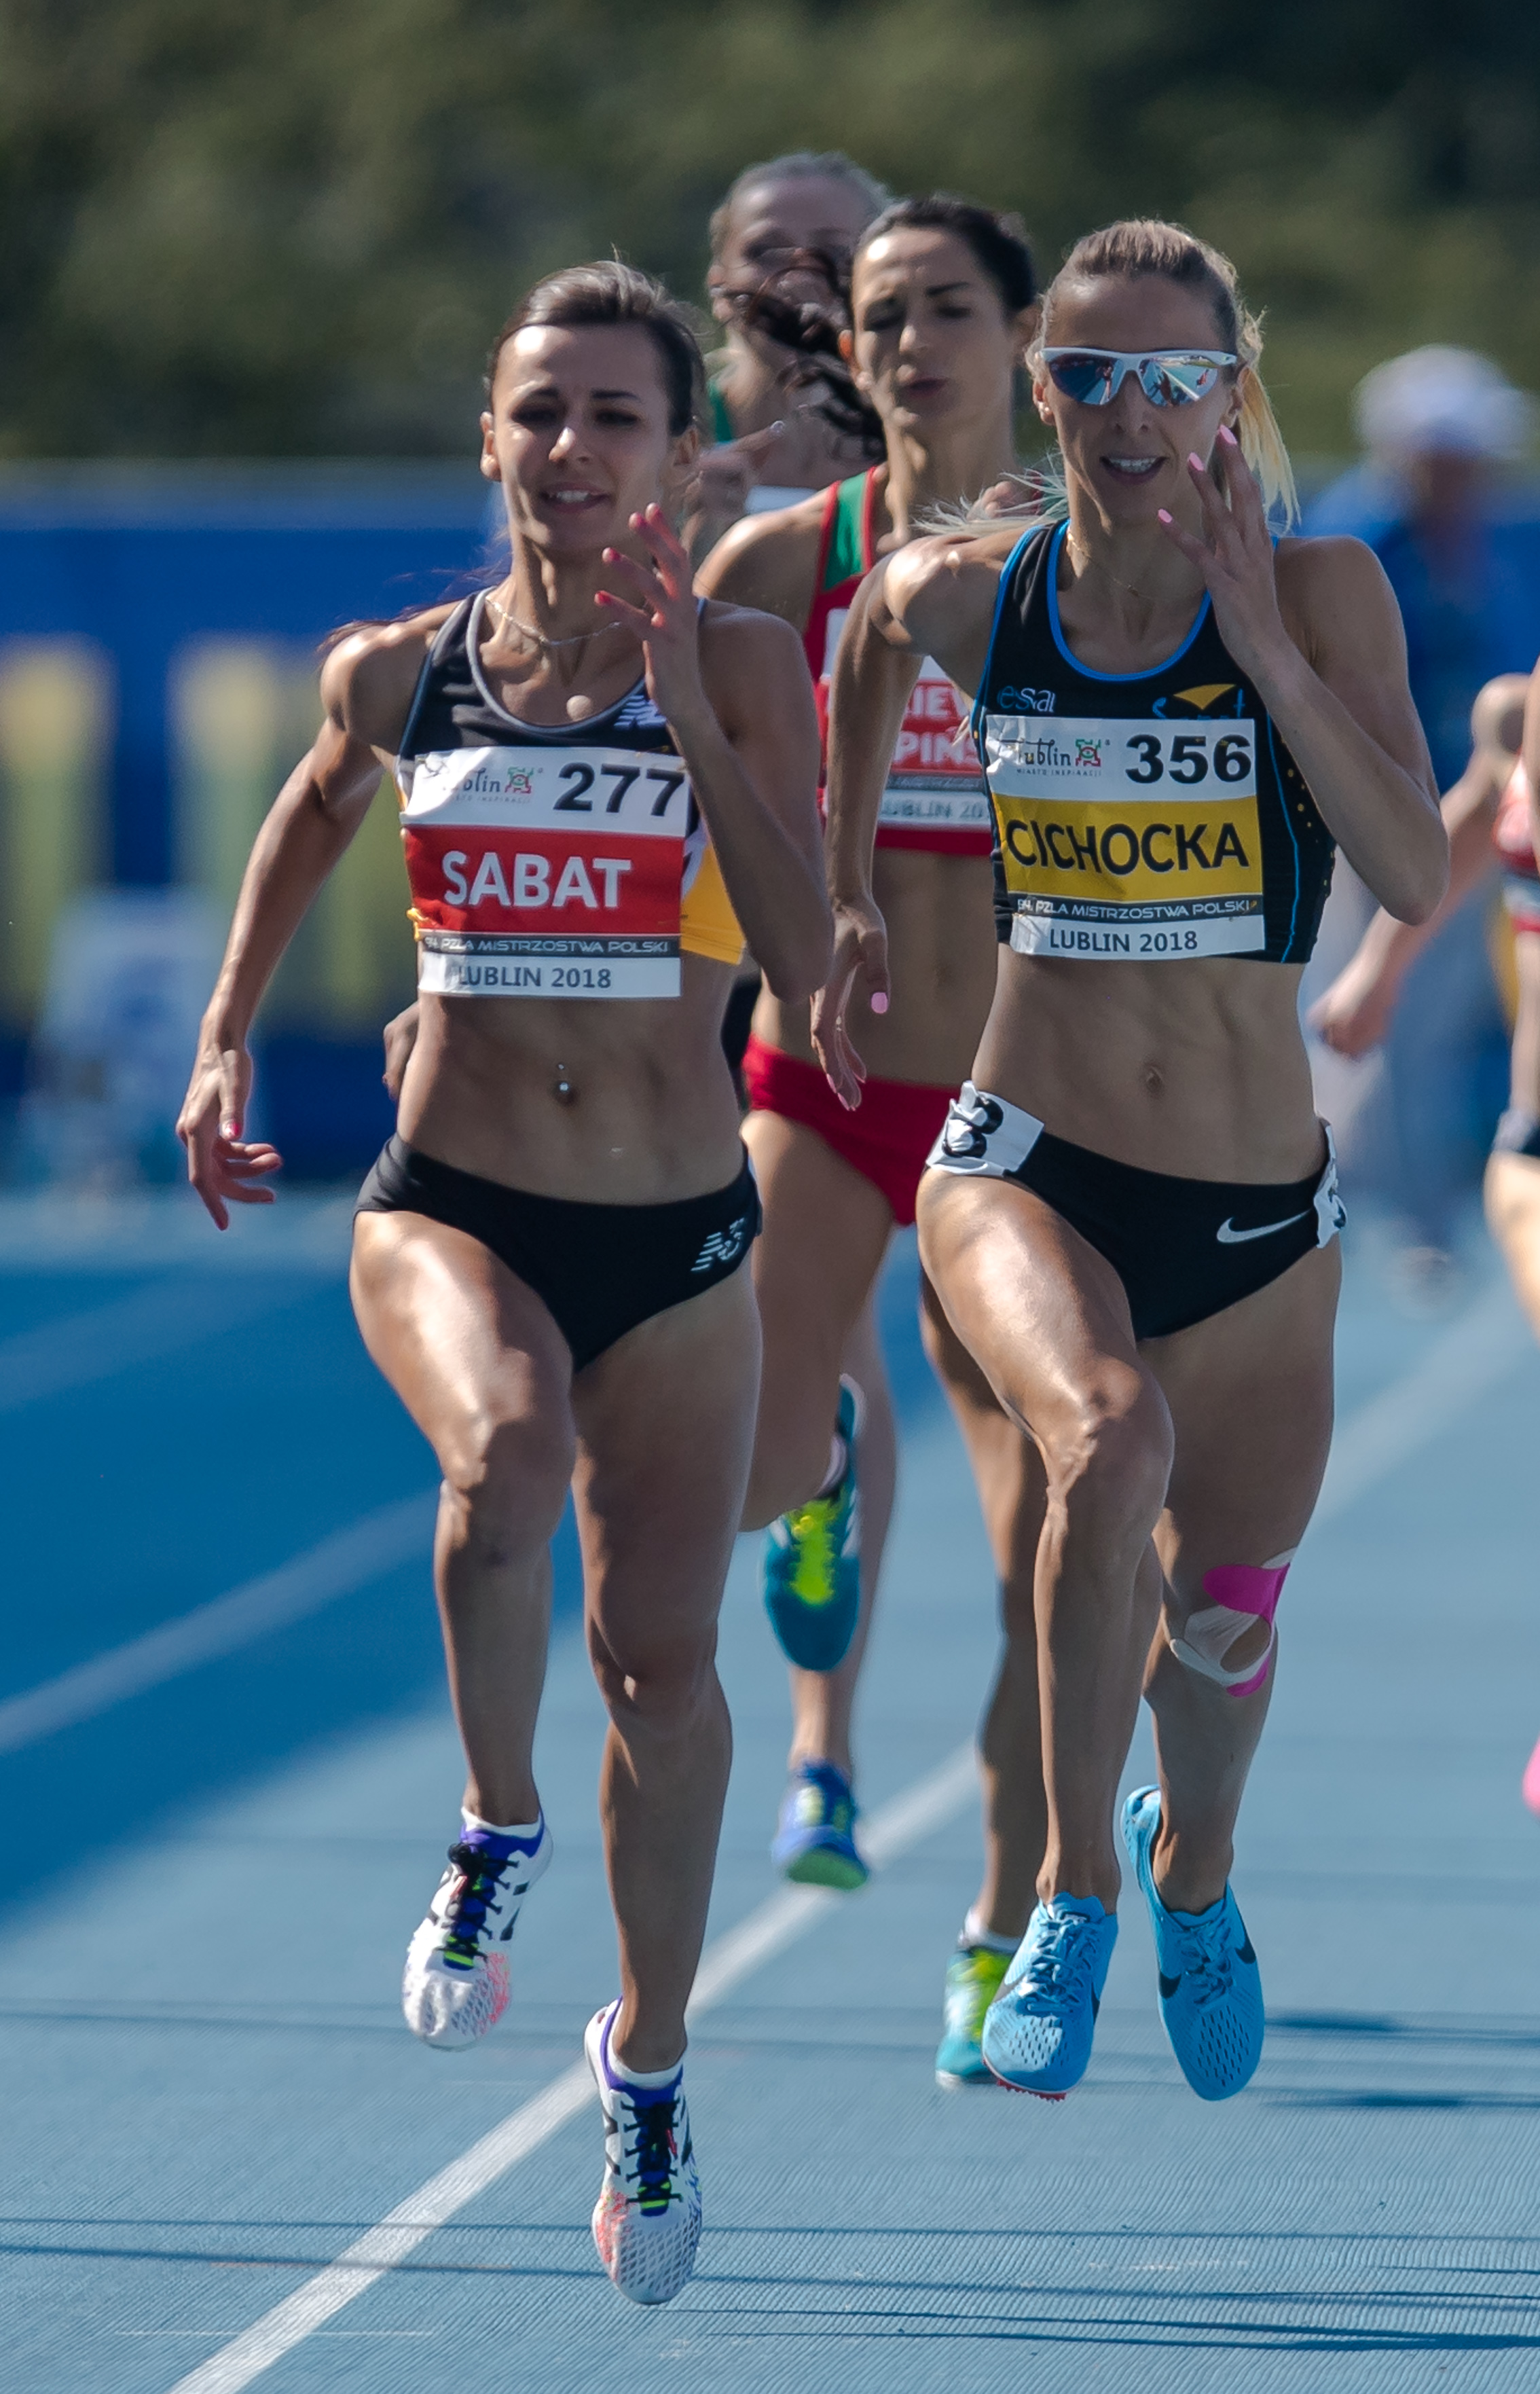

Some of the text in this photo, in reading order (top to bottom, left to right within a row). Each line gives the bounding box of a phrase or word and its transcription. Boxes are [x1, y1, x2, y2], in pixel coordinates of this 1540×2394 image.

[1124, 734, 1251, 784] 356
[553, 762, 684, 817] 277
[1006, 819, 1249, 875] CICHOCKA
[442, 850, 631, 909] SABAT
[1071, 905, 1189, 919] MISTRZOSTWA
[1192, 900, 1249, 915] POLSKI
[477, 940, 604, 953] MISTRZOSTWA
[608, 941, 668, 953] POLSKI
[1050, 928, 1198, 952] LUBLIN 2018
[459, 966, 611, 988] LUBLIN 2018
